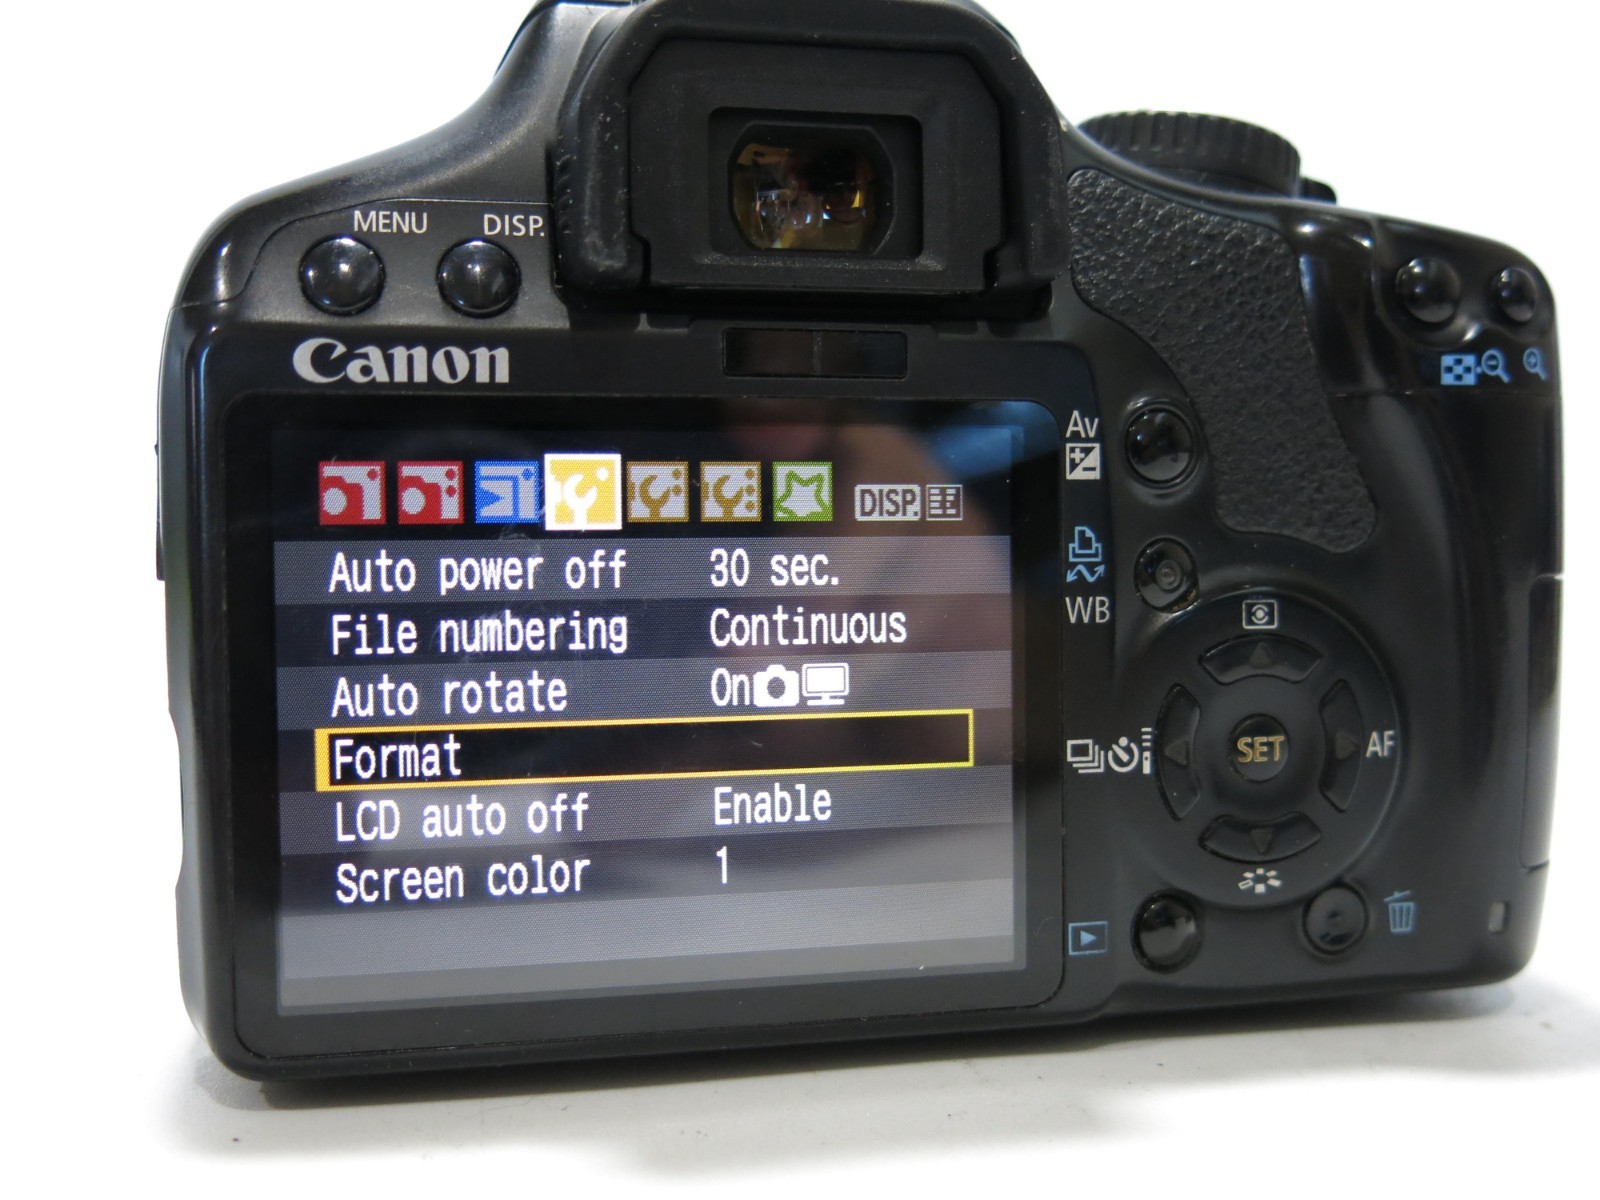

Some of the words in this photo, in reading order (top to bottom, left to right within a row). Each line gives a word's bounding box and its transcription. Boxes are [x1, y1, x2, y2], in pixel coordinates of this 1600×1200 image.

[354, 210, 427, 233] MENU
[484, 214, 544, 236] DISP.
[293, 338, 508, 383] Canon
[1065, 410, 1099, 438] Av
[859, 488, 919, 517] DISP.
[328, 550, 416, 592] Auto
[439, 557, 543, 595] power
[565, 549, 626, 589] off
[710, 548, 749, 586] 30
[771, 554, 838, 586] sec.
[710, 605, 906, 646] Continuous
[1066, 597, 1109, 623] WB
[332, 614, 416, 654] File
[439, 610, 627, 653] numbering
[332, 674, 418, 717] Auto
[444, 670, 567, 714] rotate
[711, 668, 750, 706] On
[336, 734, 462, 780] Format
[1237, 735, 1285, 763] SET
[1366, 731, 1394, 757] AF
[336, 800, 400, 841] LCD
[422, 794, 507, 838] auto
[526, 793, 588, 834] off
[714, 783, 831, 826] Enable
[336, 862, 464, 904] Screen
[488, 855, 590, 895] color
[717, 846, 727, 884] 1
